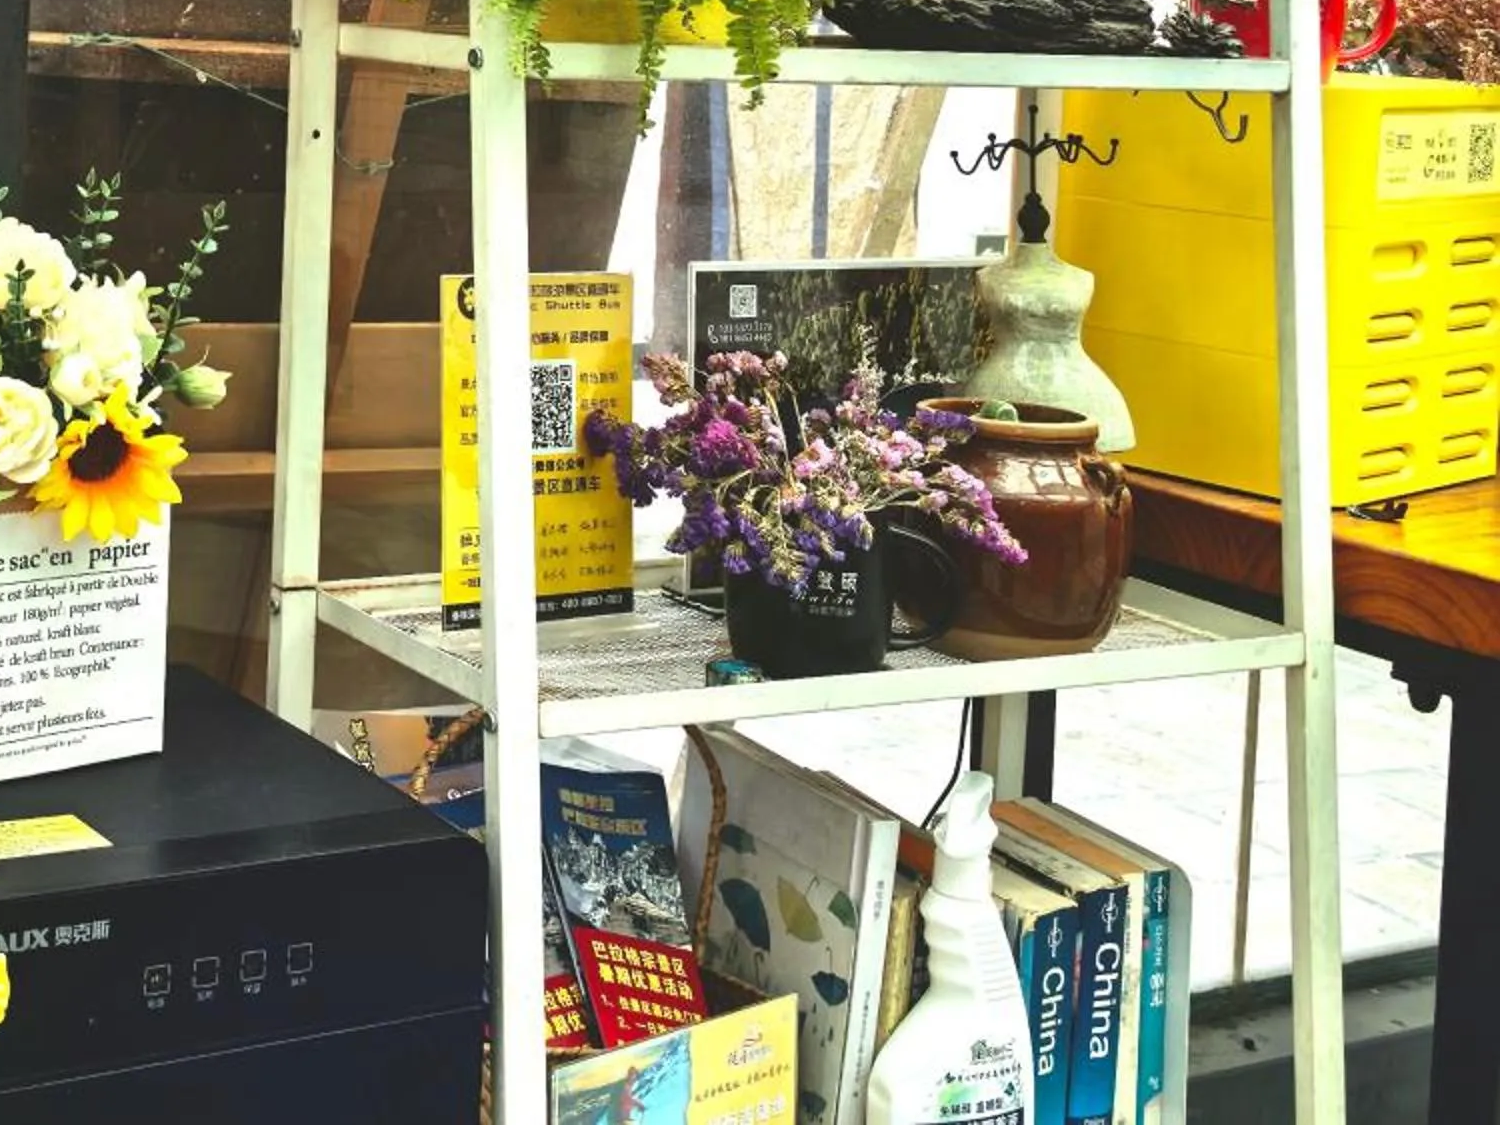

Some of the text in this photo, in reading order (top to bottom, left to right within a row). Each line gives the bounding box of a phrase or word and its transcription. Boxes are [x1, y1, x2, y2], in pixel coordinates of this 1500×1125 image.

[88, 539, 151, 569] papier
[106, 576, 120, 588] de
[121, 572, 160, 588] Double
[69, 602, 102, 618] papier
[47, 625, 72, 640] kraft
[9, 653, 22, 666] de
[23, 649, 48, 664] kraft
[54, 919, 112, 947] 奥克斯
[591, 940, 688, 977] 巴拉格宗景区
[598, 962, 693, 1001] 暑期优惠活动
[1089, 942, 1122, 1061] China
[1036, 965, 1066, 1077] China
